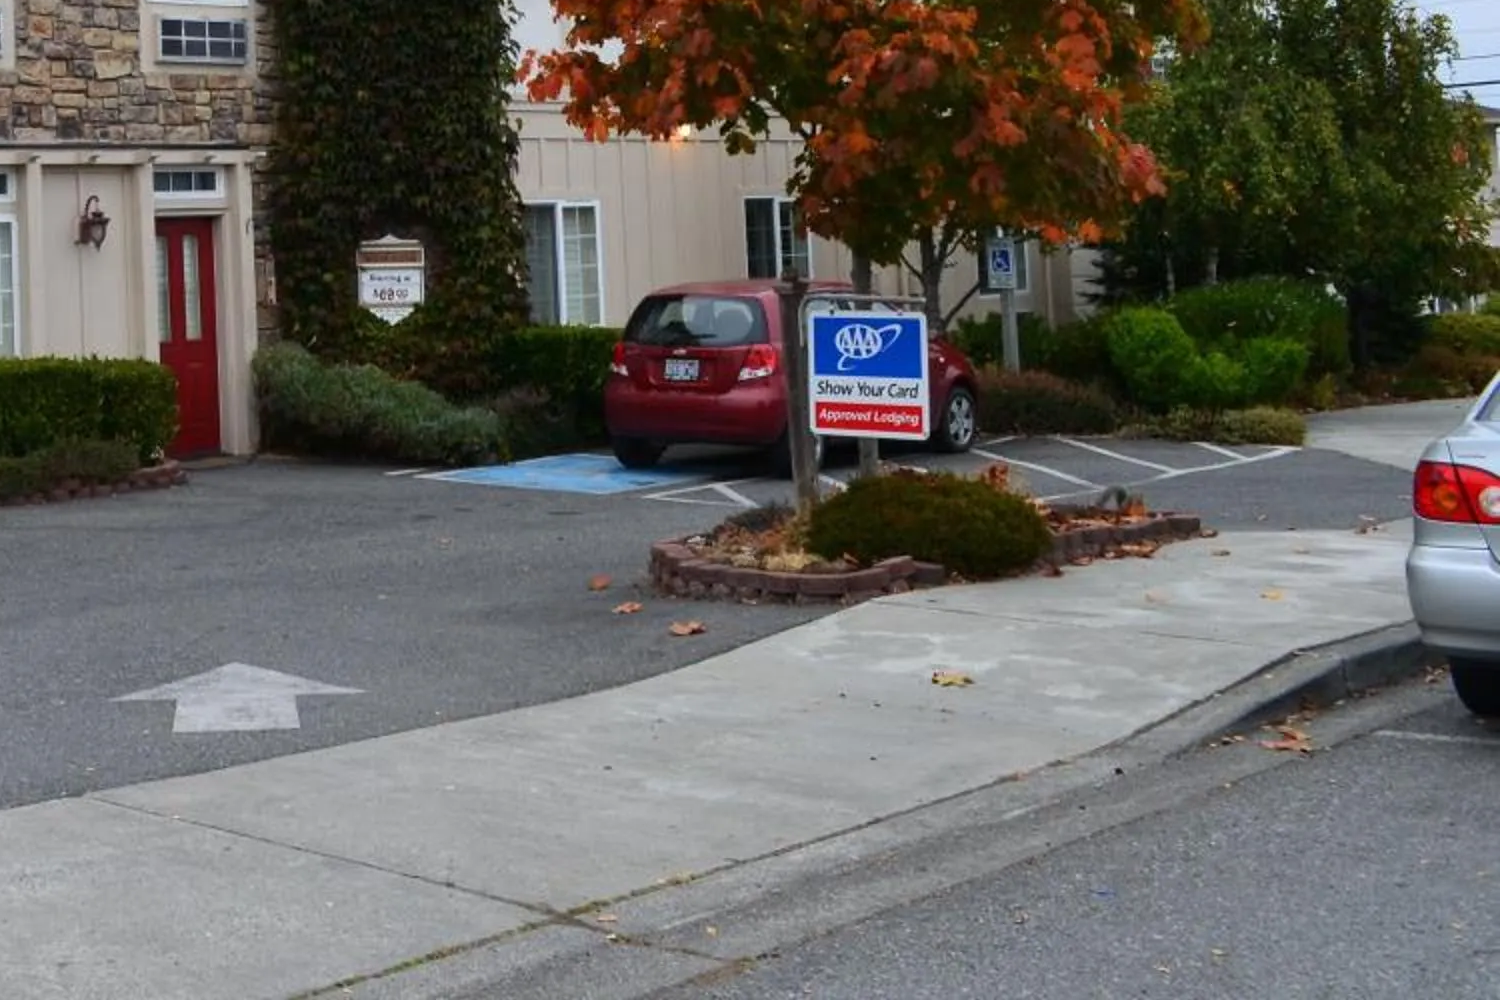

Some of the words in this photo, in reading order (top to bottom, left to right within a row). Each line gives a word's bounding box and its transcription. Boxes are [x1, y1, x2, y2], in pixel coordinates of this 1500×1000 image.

[836, 324, 881, 358] AAA
[816, 380, 854, 395] Show
[857, 382, 886, 397] Your
[888, 383, 919, 399] Card
[819, 408, 871, 422] Approved
[873, 410, 920, 428] Lodging
